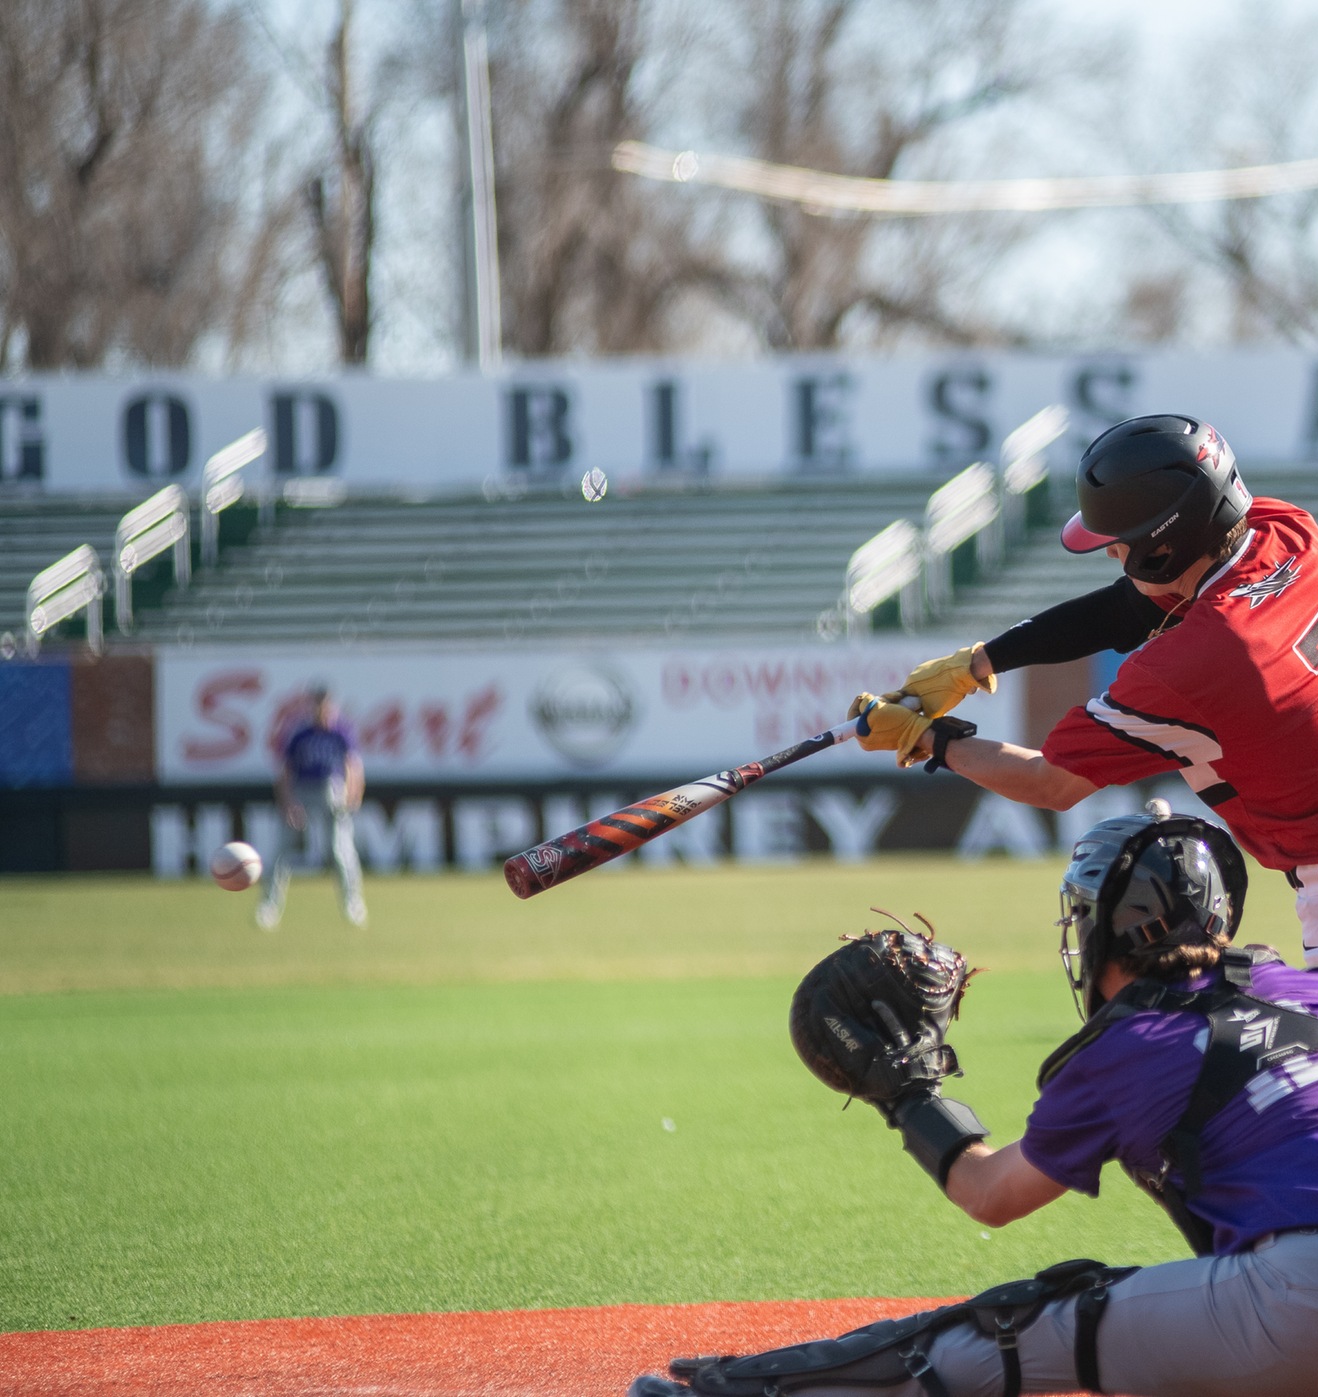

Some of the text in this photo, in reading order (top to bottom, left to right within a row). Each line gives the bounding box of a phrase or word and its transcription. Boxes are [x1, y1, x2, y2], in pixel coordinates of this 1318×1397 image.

[0, 388, 345, 480] GOD
[503, 366, 1142, 478] BLESS
[1150, 511, 1180, 538] EASTON
[824, 1017, 859, 1054] ALL-STAR
